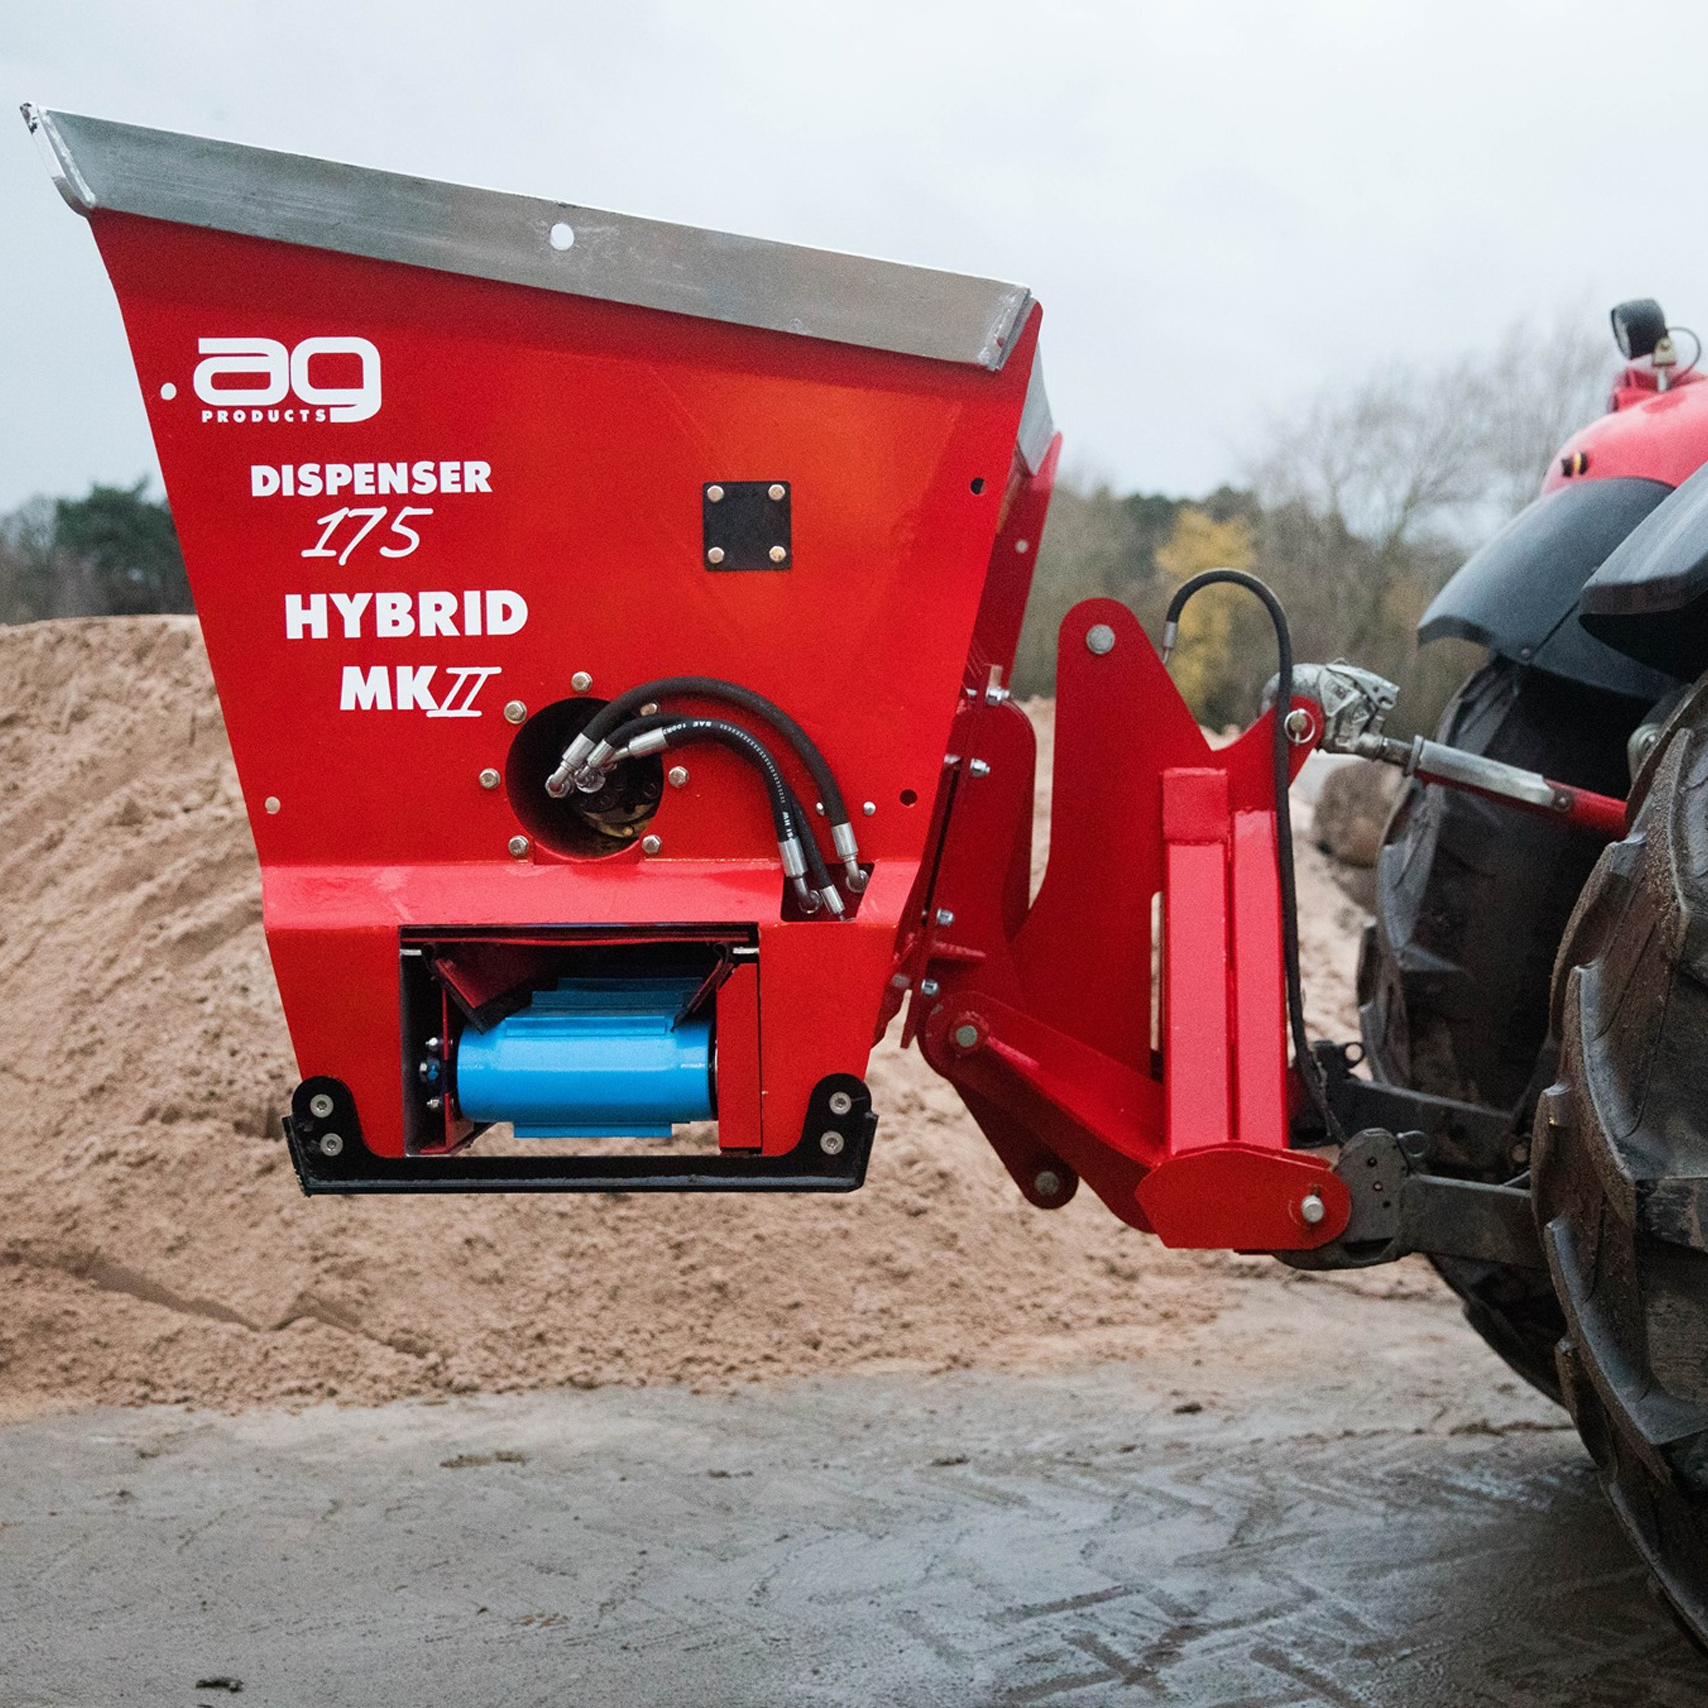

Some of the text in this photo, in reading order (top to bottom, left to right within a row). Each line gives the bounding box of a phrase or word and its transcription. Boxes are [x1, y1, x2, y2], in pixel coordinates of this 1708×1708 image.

[193, 336, 382, 423] ag
[201, 409, 327, 423] PRODUCTS
[250, 461, 493, 497] DISPENSER
[301, 506, 434, 565] 175
[285, 589, 529, 639] HYBRID
